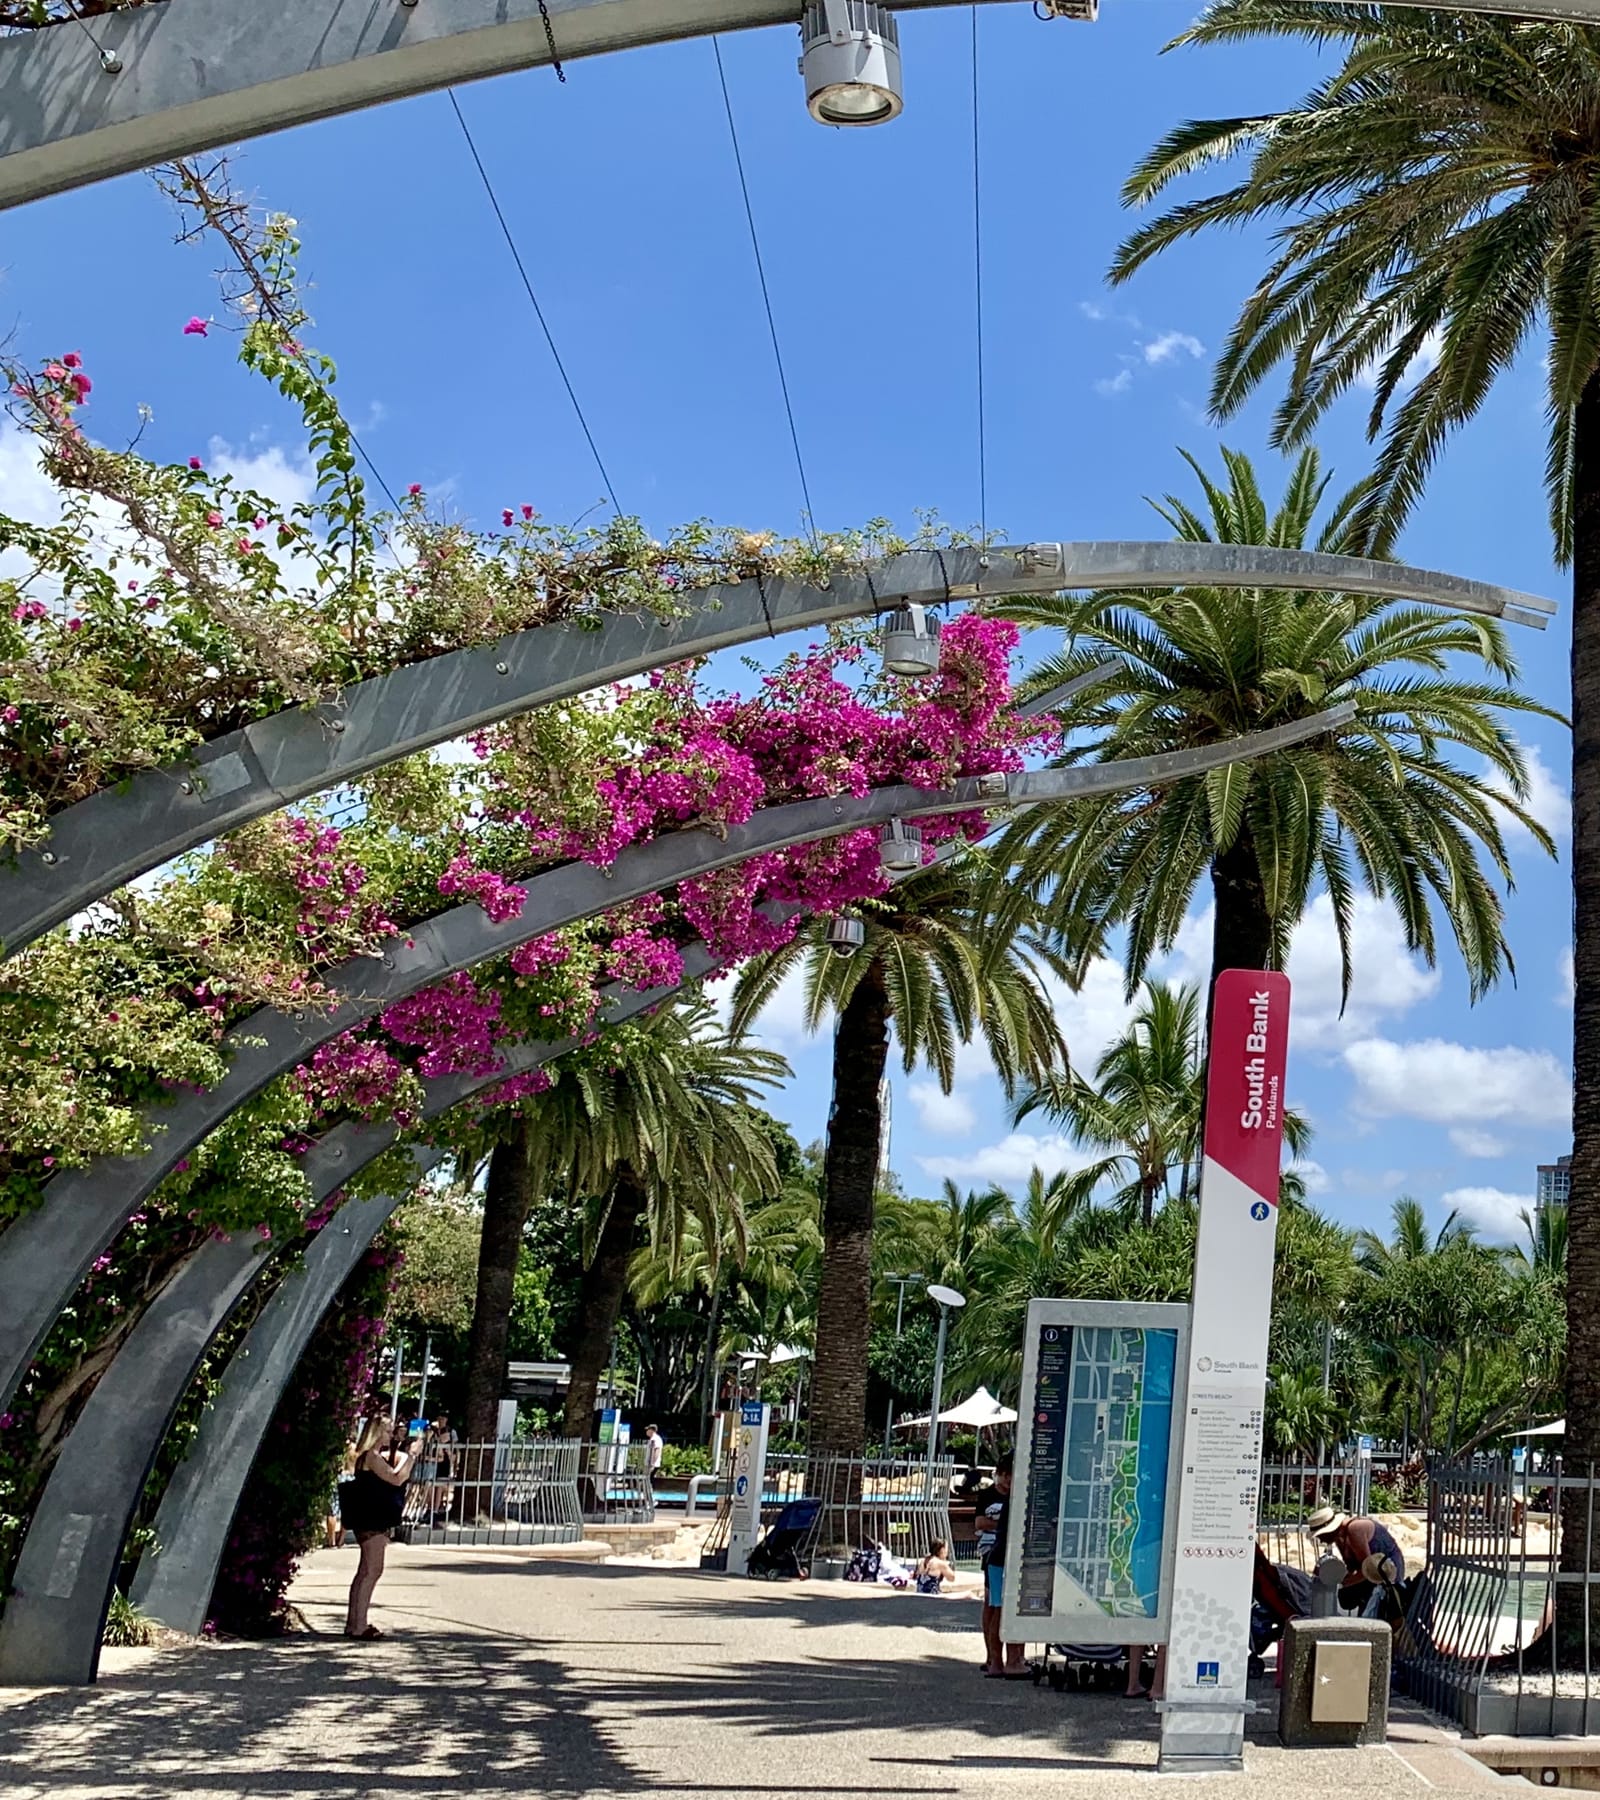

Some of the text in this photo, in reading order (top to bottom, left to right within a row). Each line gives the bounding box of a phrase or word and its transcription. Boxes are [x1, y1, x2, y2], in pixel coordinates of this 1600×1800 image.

[1241, 990, 1270, 1130] South Bank
[1266, 1075, 1279, 1129] Parklands
[1214, 1360, 1259, 1370] South Bank
